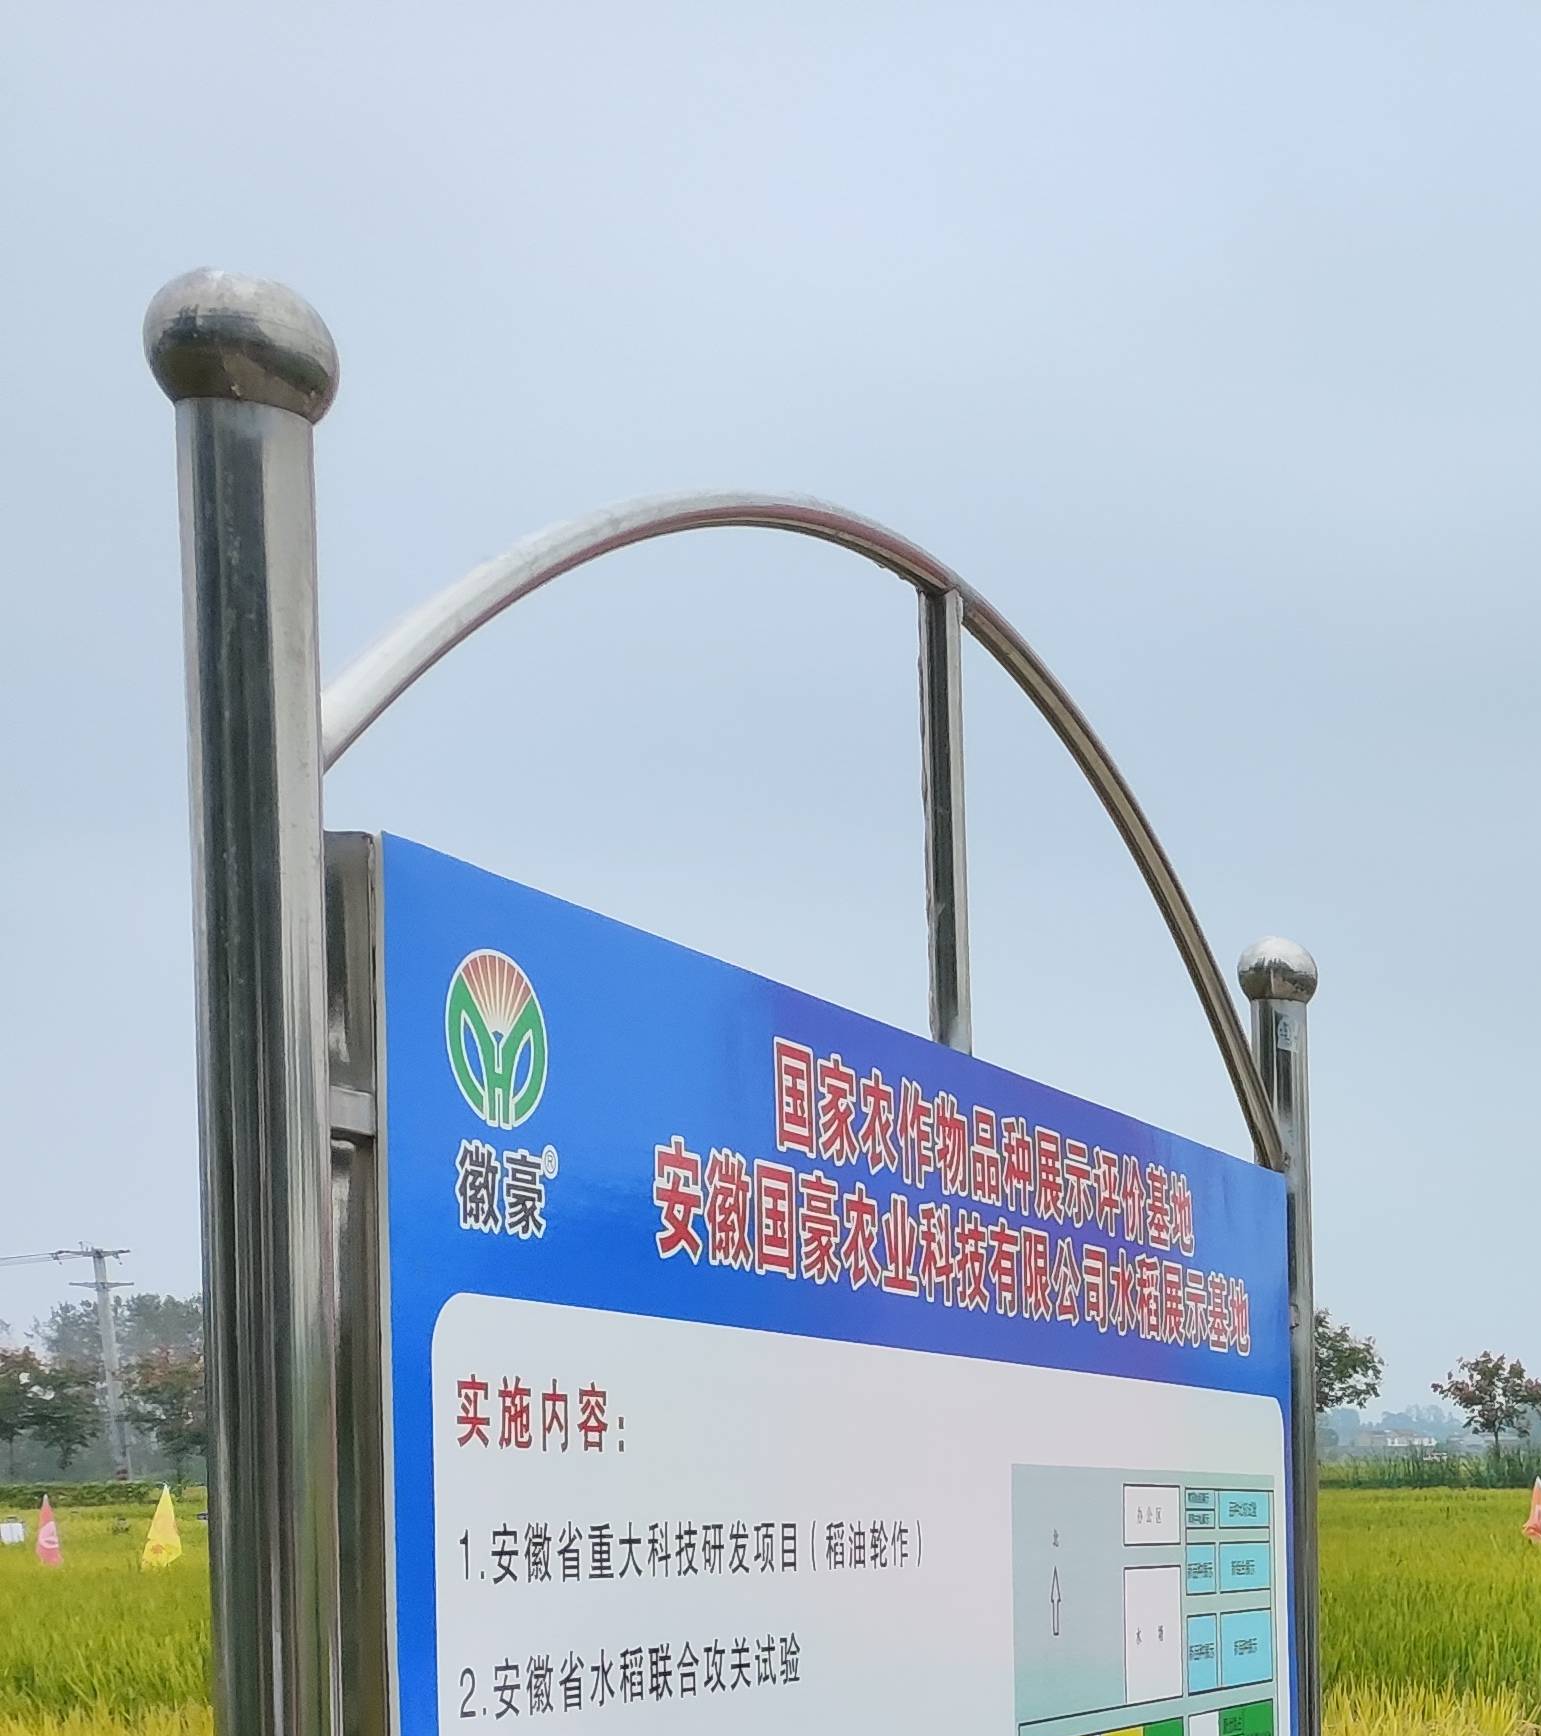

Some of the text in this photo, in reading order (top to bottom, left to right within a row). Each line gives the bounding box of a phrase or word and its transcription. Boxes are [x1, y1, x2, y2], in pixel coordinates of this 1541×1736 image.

[772, 1034, 1196, 1257] 国家农作物品种展示评价基地
[653, 1135, 1252, 1358] 安徽国豪农业科技有限公司水稻展示基地
[456, 1373, 626, 1453] 实施内容：
[458, 1632, 802, 1720] 2.安徽省水稻联合攻关试验
